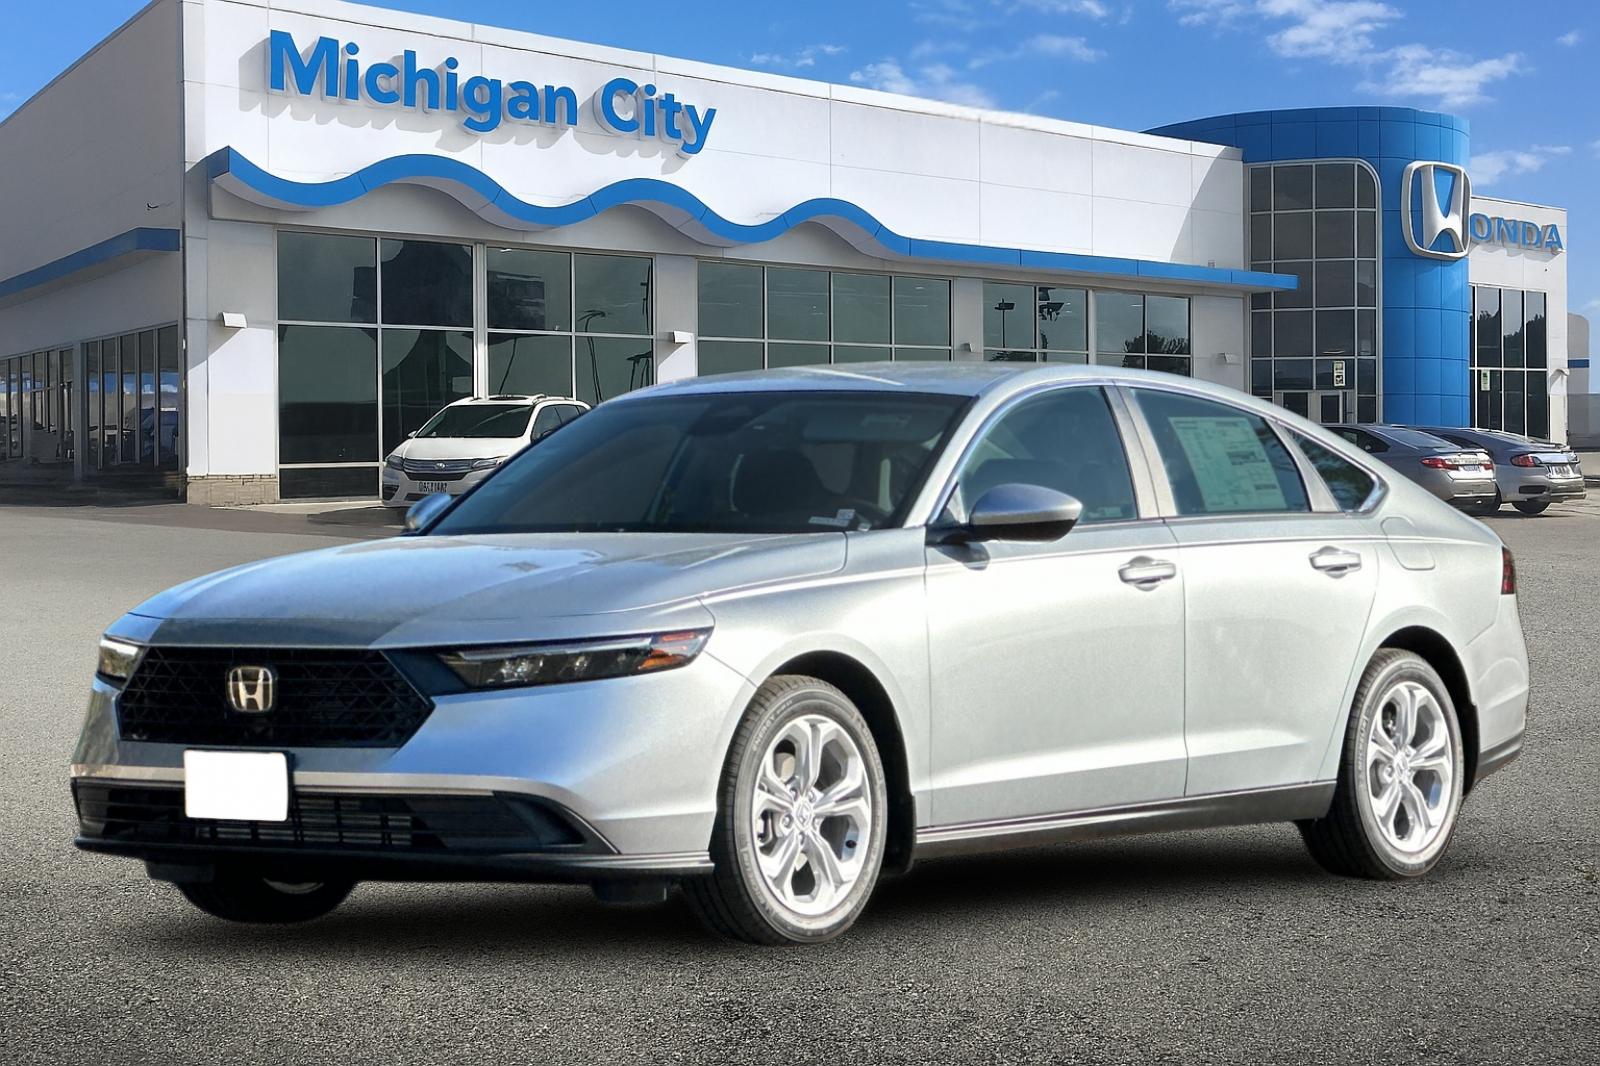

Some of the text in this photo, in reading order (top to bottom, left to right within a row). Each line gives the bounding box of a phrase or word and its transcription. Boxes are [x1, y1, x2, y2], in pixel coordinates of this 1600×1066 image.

[269, 30, 717, 155] Michigan City
[1469, 212, 1564, 250] ONDA
